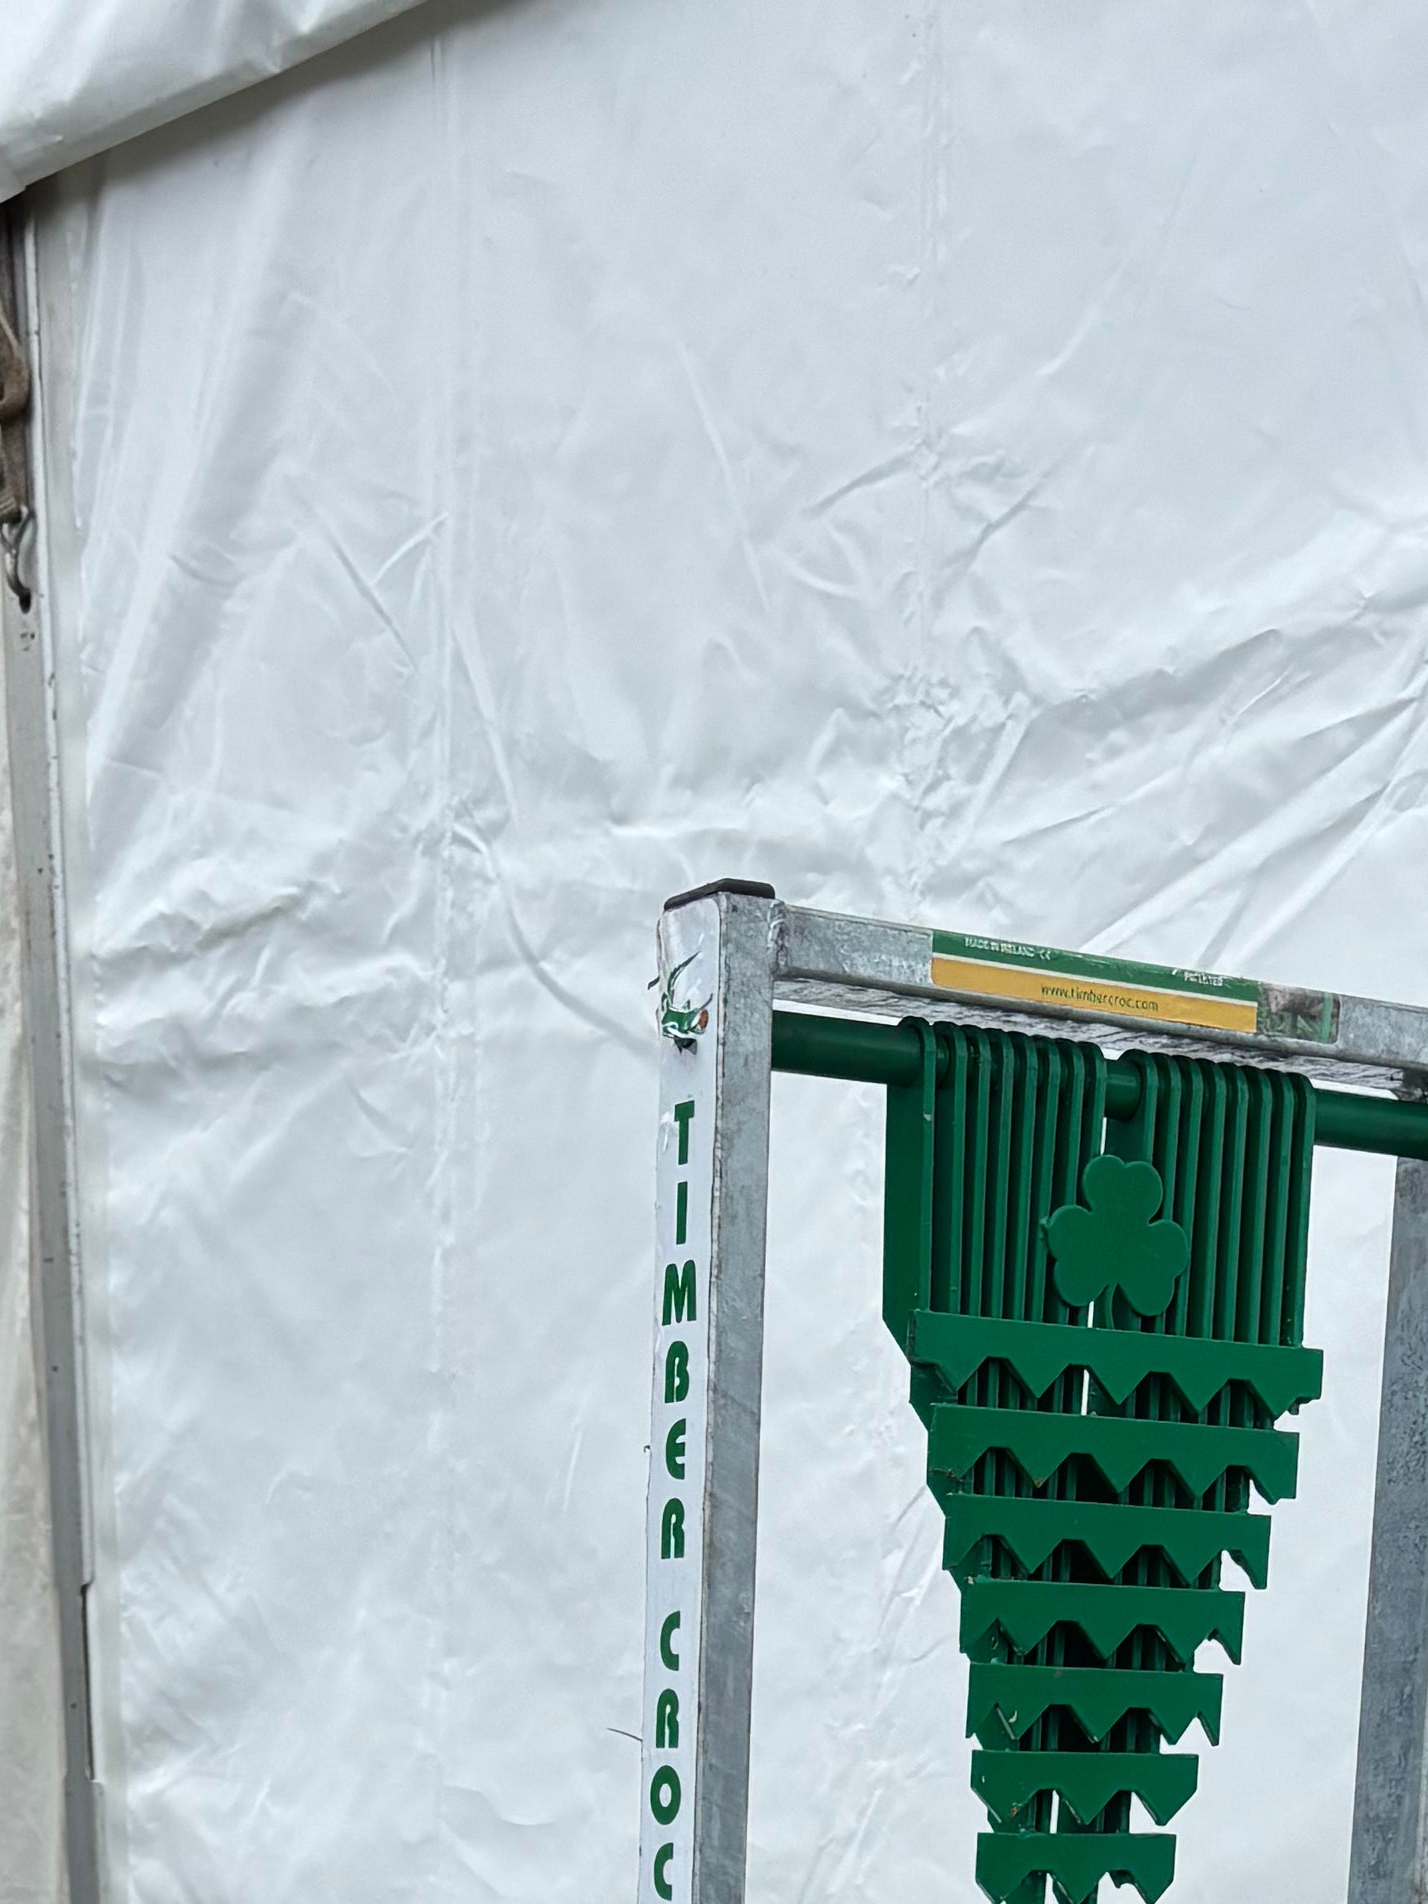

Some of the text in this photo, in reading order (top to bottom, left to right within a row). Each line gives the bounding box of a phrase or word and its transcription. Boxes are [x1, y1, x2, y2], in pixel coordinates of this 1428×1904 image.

[1041, 985, 1159, 1012] www.timbercroc.com
[661, 1100, 697, 1559] TIMBER
[650, 1611, 682, 1901] CROC
